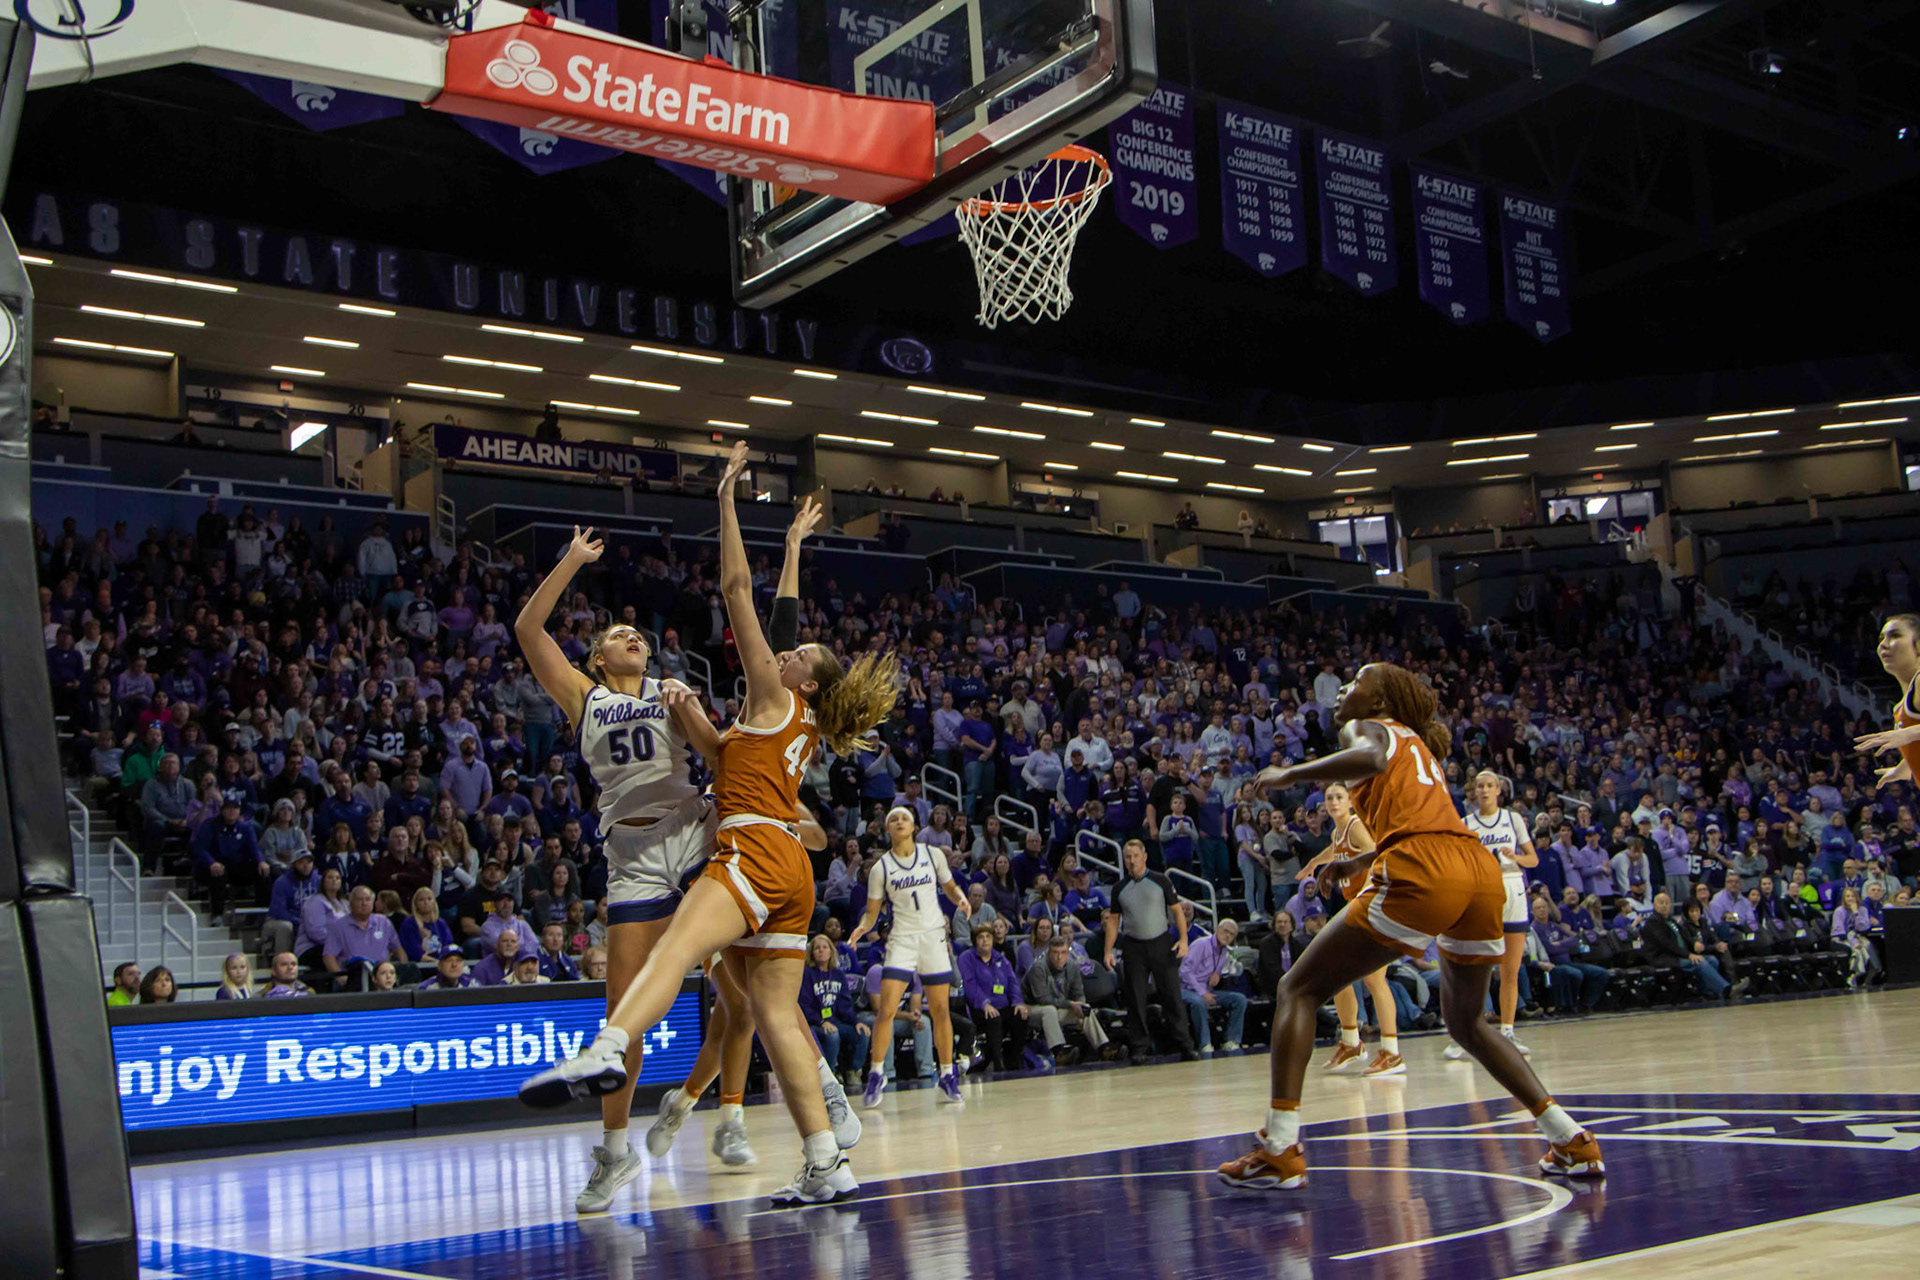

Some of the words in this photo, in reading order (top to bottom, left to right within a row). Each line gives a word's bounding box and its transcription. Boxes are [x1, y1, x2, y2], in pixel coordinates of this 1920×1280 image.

[1132, 118, 1155, 137] BIG
[1157, 126, 1174, 142] 12
[1224, 111, 1293, 144] K-STATE
[1116, 132, 1193, 163] CONFERENCE
[1234, 147, 1288, 169] CONFERENCE
[1322, 138, 1384, 168] K-STATE
[1116, 147, 1194, 182] CHAMPIONS
[1227, 156, 1297, 182] CHAMPIONSHIPS
[1236, 178, 1258, 193] 1917
[1268, 185, 1289, 200] 1951
[1325, 180, 1389, 204] CHAMPIONSHIPS
[1331, 171, 1380, 192] CONFERENCE
[1417, 174, 1476, 203] K-STATE
[1130, 181, 1185, 216] 2019
[1237, 192, 1259, 207] 1919
[1269, 200, 1291, 215] 1956
[1503, 196, 1557, 223] K-STATE
[1237, 207, 1260, 222] 1948
[1270, 214, 1293, 229] 1958
[1238, 221, 1261, 236] 1950
[1270, 228, 1294, 242] 1959
[185, 219, 399, 298] STATE
[454, 263, 818, 360] UNIVERSITY
[348, 403, 365, 415] 20
[653, 439, 668, 450] 20
[593, 702, 665, 728] Wildcats
[381, 732, 405, 756] 22
[608, 725, 655, 765] 50
[891, 874, 933, 891] Wildcats
[911, 890, 920, 911] 1
[118, 1045, 247, 1105] njoy
[266, 1021, 585, 1088] Responsibly
